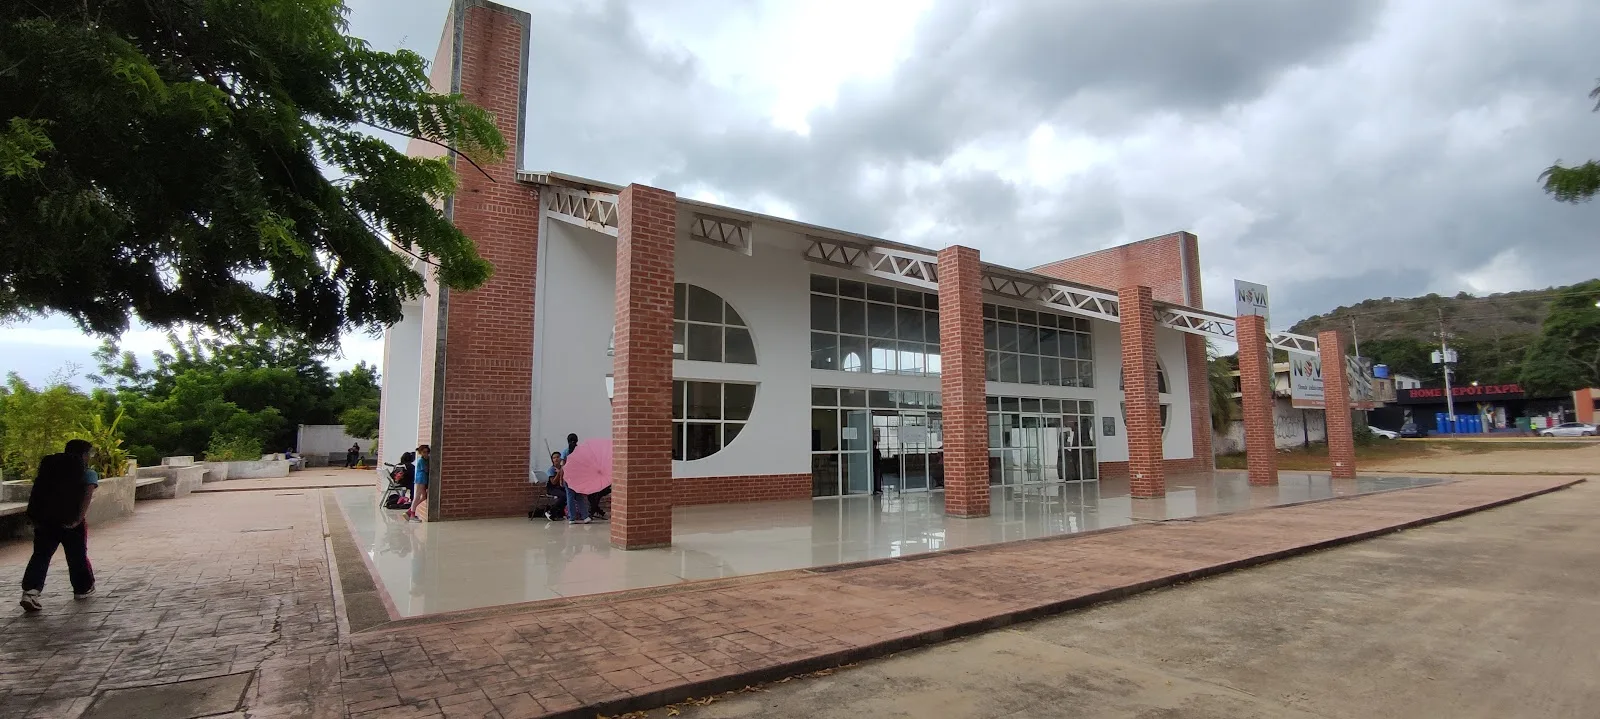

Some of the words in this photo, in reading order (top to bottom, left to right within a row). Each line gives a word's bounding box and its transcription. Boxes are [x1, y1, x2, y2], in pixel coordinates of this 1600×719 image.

[1238, 289, 1266, 305] NOVA
[1293, 359, 1322, 378] NOV
[1410, 388, 1440, 398] HOME
